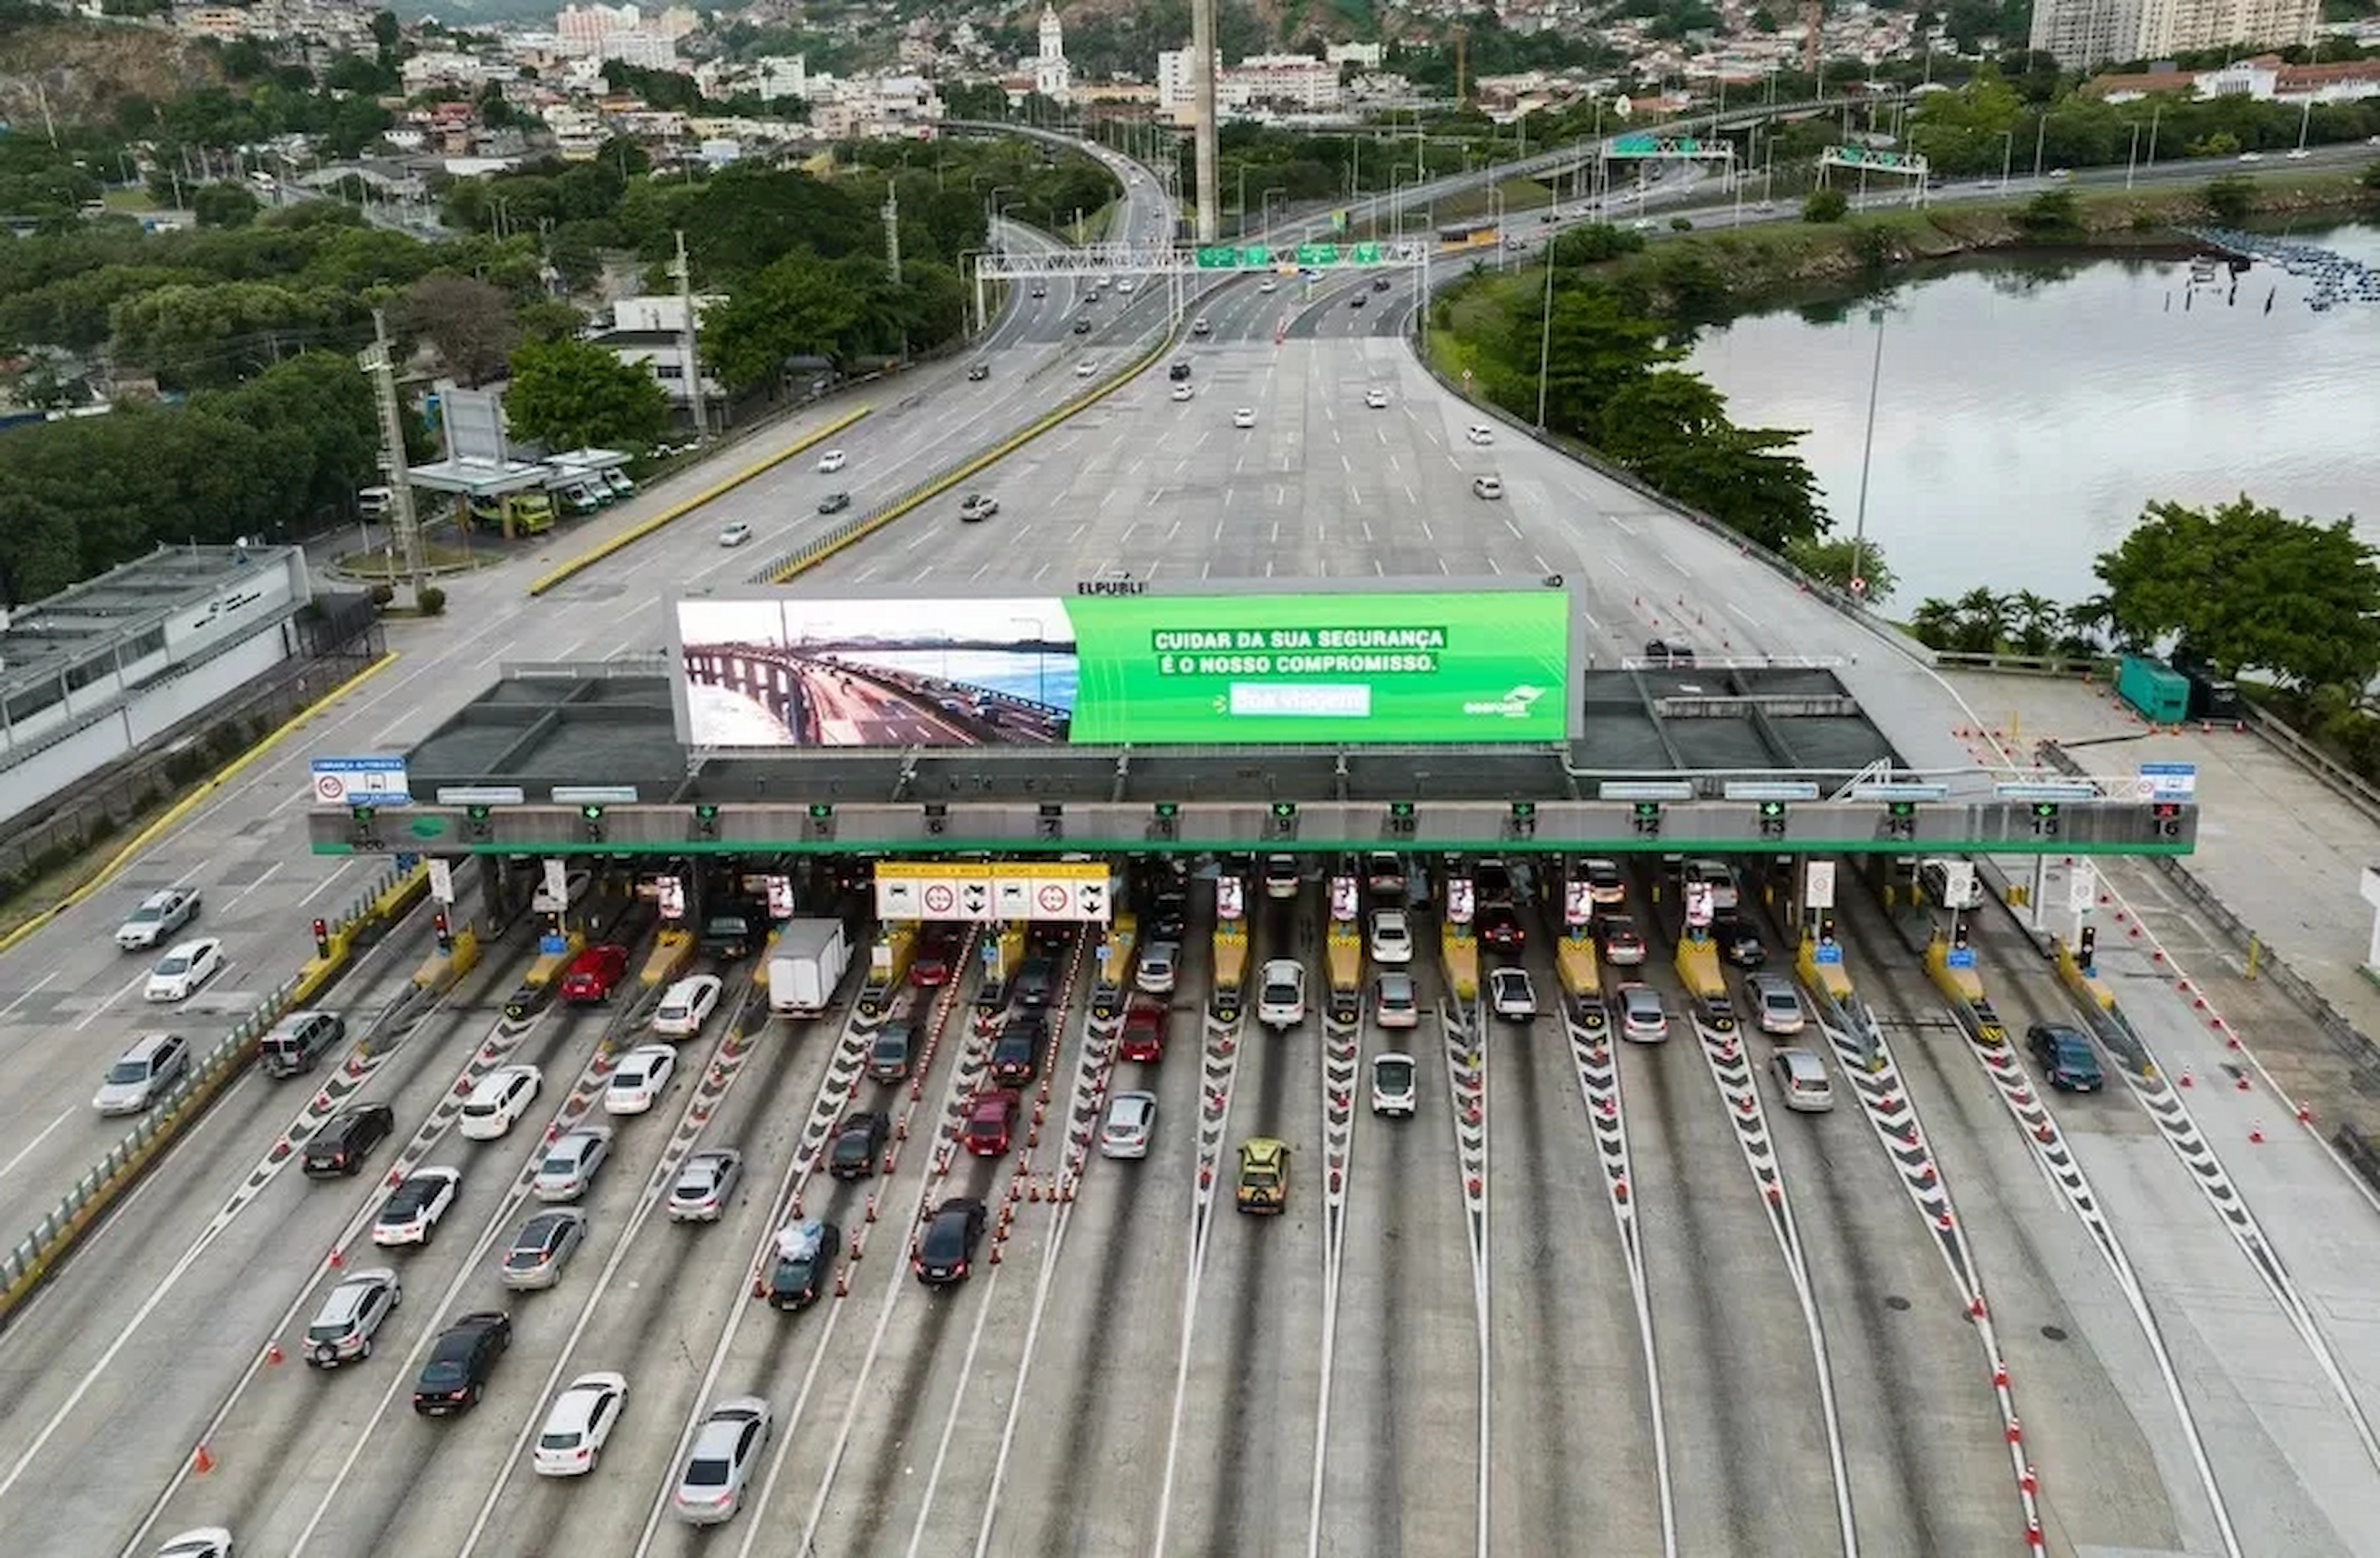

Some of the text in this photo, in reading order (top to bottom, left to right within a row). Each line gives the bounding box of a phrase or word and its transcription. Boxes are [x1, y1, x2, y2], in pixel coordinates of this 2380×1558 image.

[1155, 629, 1444, 651] CUIDAR DA SUA SEGURANÇA
[1162, 653, 1437, 674] É O NOSSO COMPROMISSO.
[701, 821, 713, 835] 4
[930, 819, 942, 833] 6
[1044, 819, 1056, 832] 7
[1279, 819, 1290, 832] 9
[1391, 819, 1414, 832] 10
[1513, 819, 1535, 833] 11
[1633, 819, 1659, 834] 12
[1760, 819, 1785, 833] 13
[1884, 819, 1913, 833] 14
[2030, 819, 2057, 835] 15
[2153, 819, 2178, 835] 16
